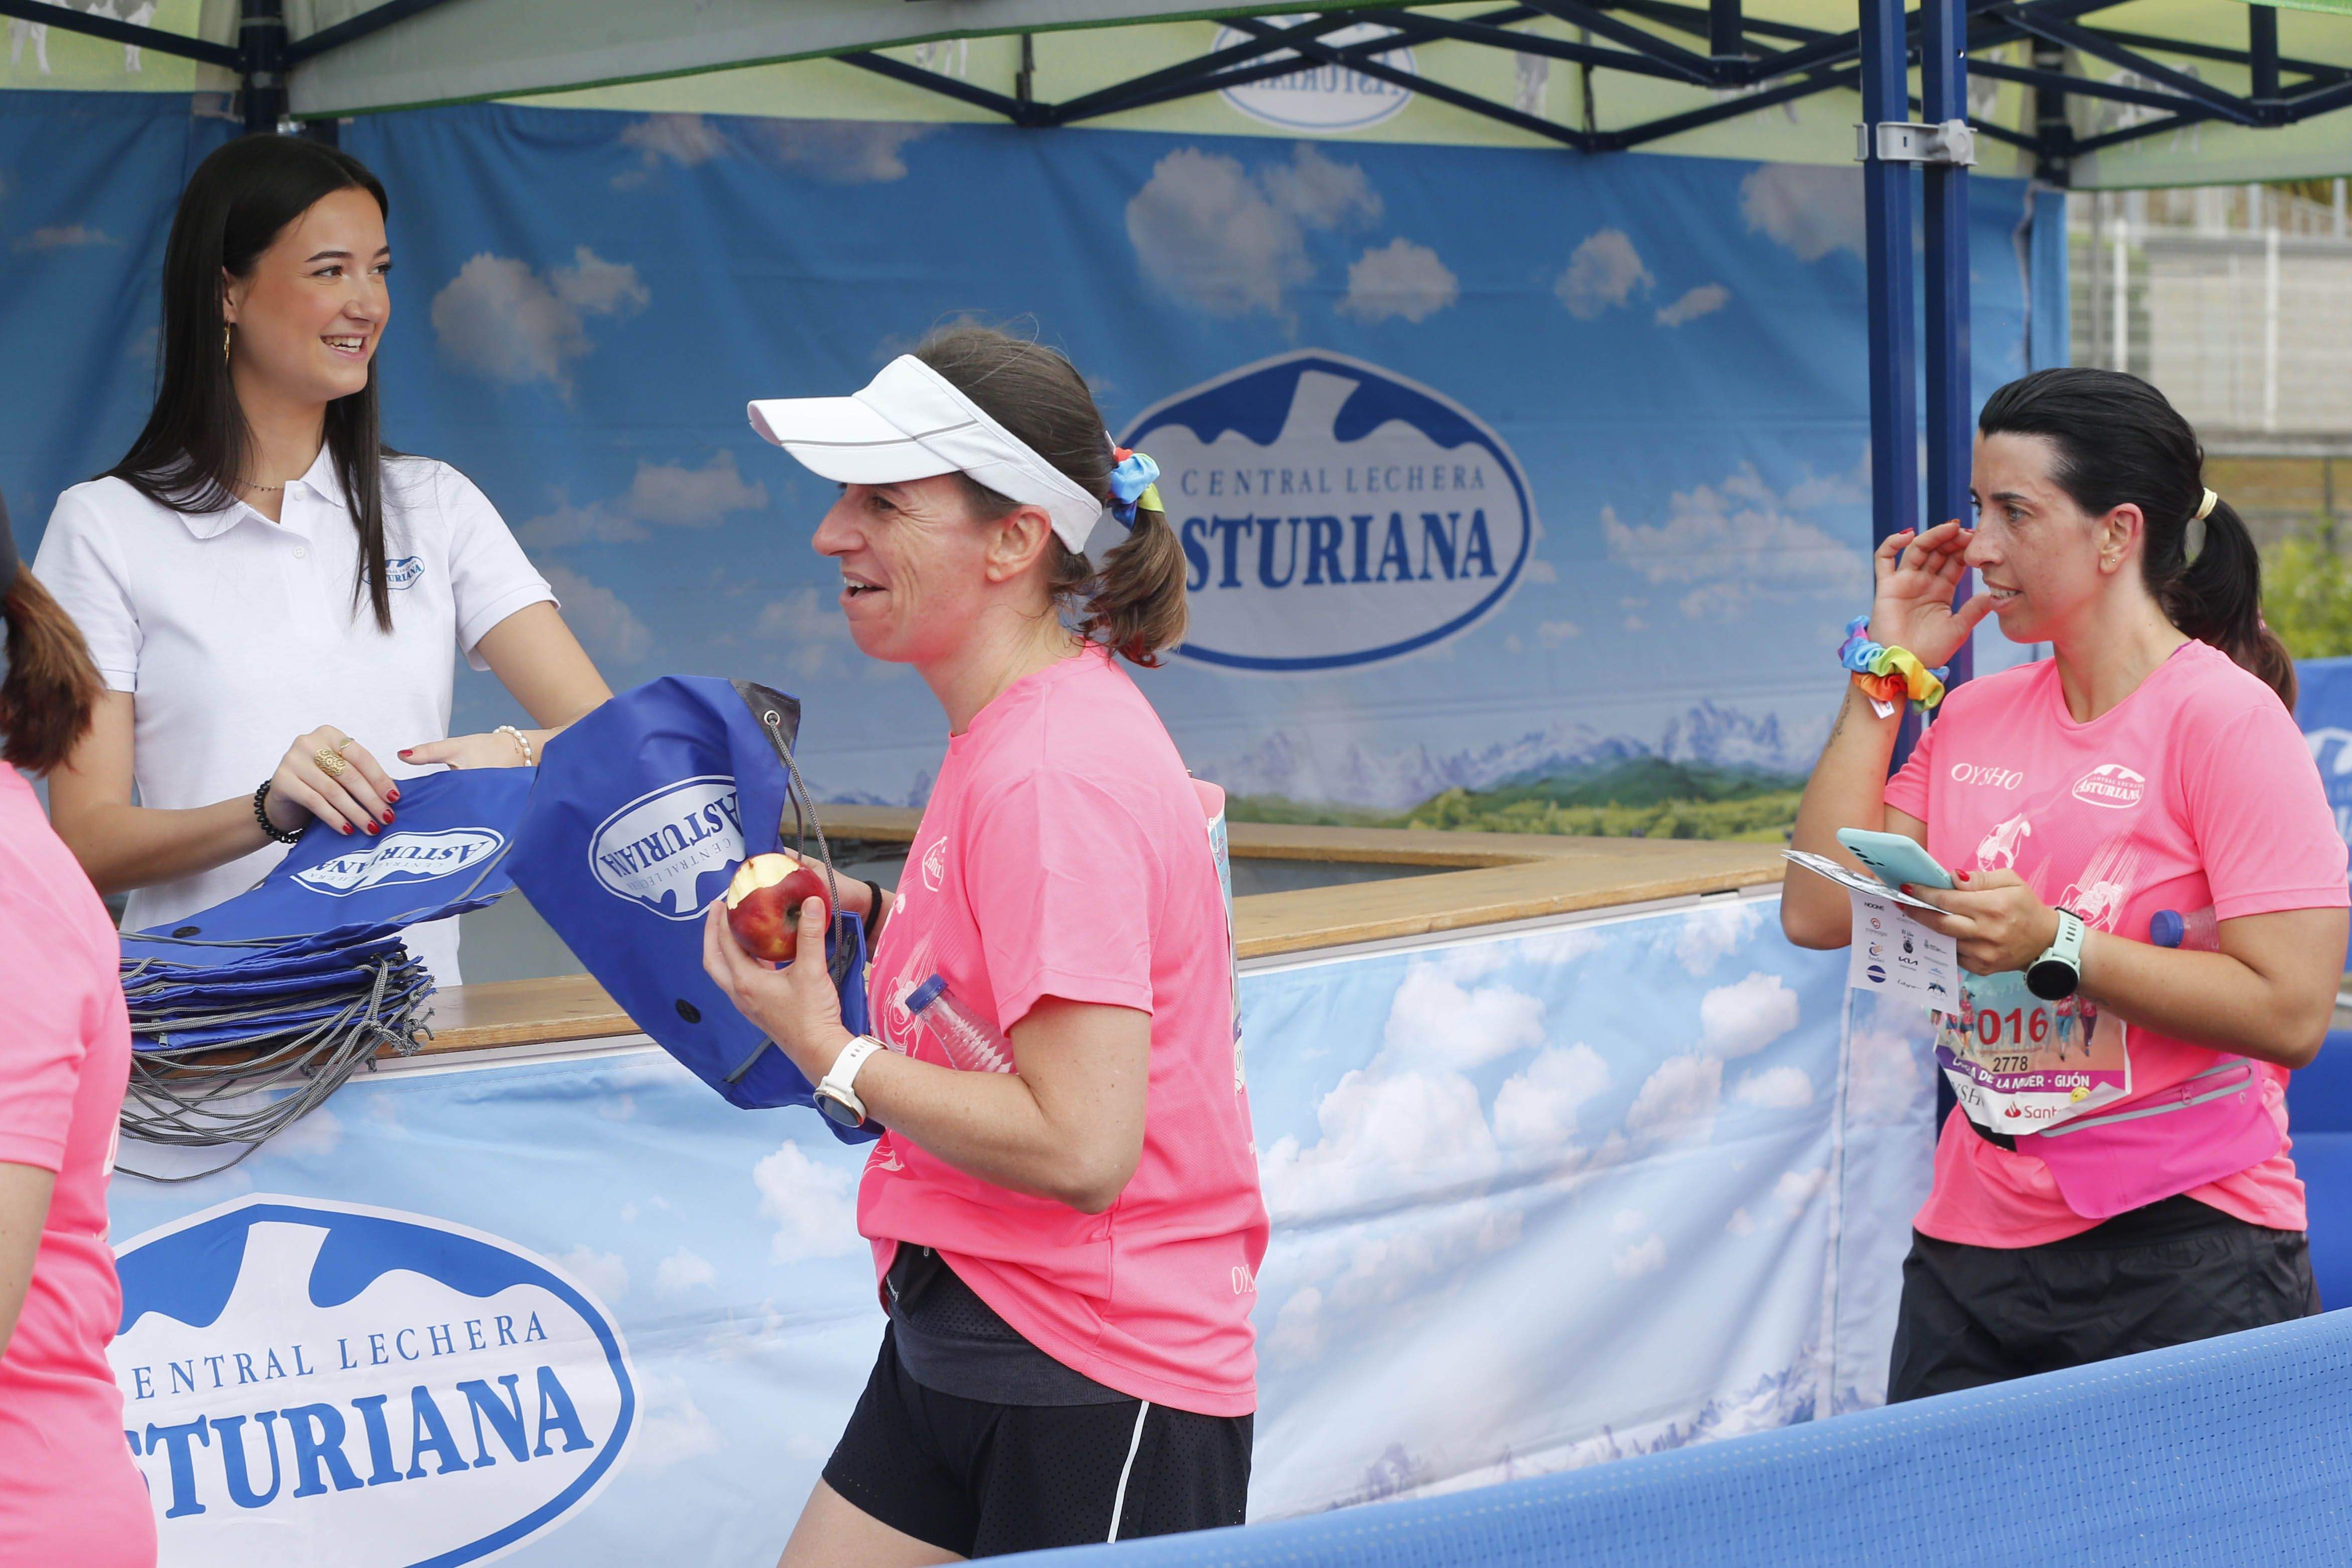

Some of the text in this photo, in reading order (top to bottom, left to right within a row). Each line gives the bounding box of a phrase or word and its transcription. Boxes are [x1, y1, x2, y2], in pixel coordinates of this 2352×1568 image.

[1181, 465, 1487, 497] CENTRAL LECHERA
[1181, 508, 1498, 592] STURIANA
[1951, 762, 2023, 791] OYSHO
[665, 838, 731, 877] CENTRAL
[1978, 1069, 1995, 1083] DE
[1996, 1078, 2009, 1088] LA
[2055, 1071, 2090, 1087] GIJÓN
[1992, 1056, 2028, 1072] 2778
[2024, 1105, 2058, 1119] Sant
[1231, 1264, 1257, 1295] OYS
[132, 1310, 549, 1400] ENTRAL LECHERA
[124, 1364, 595, 1520] TURIANA
